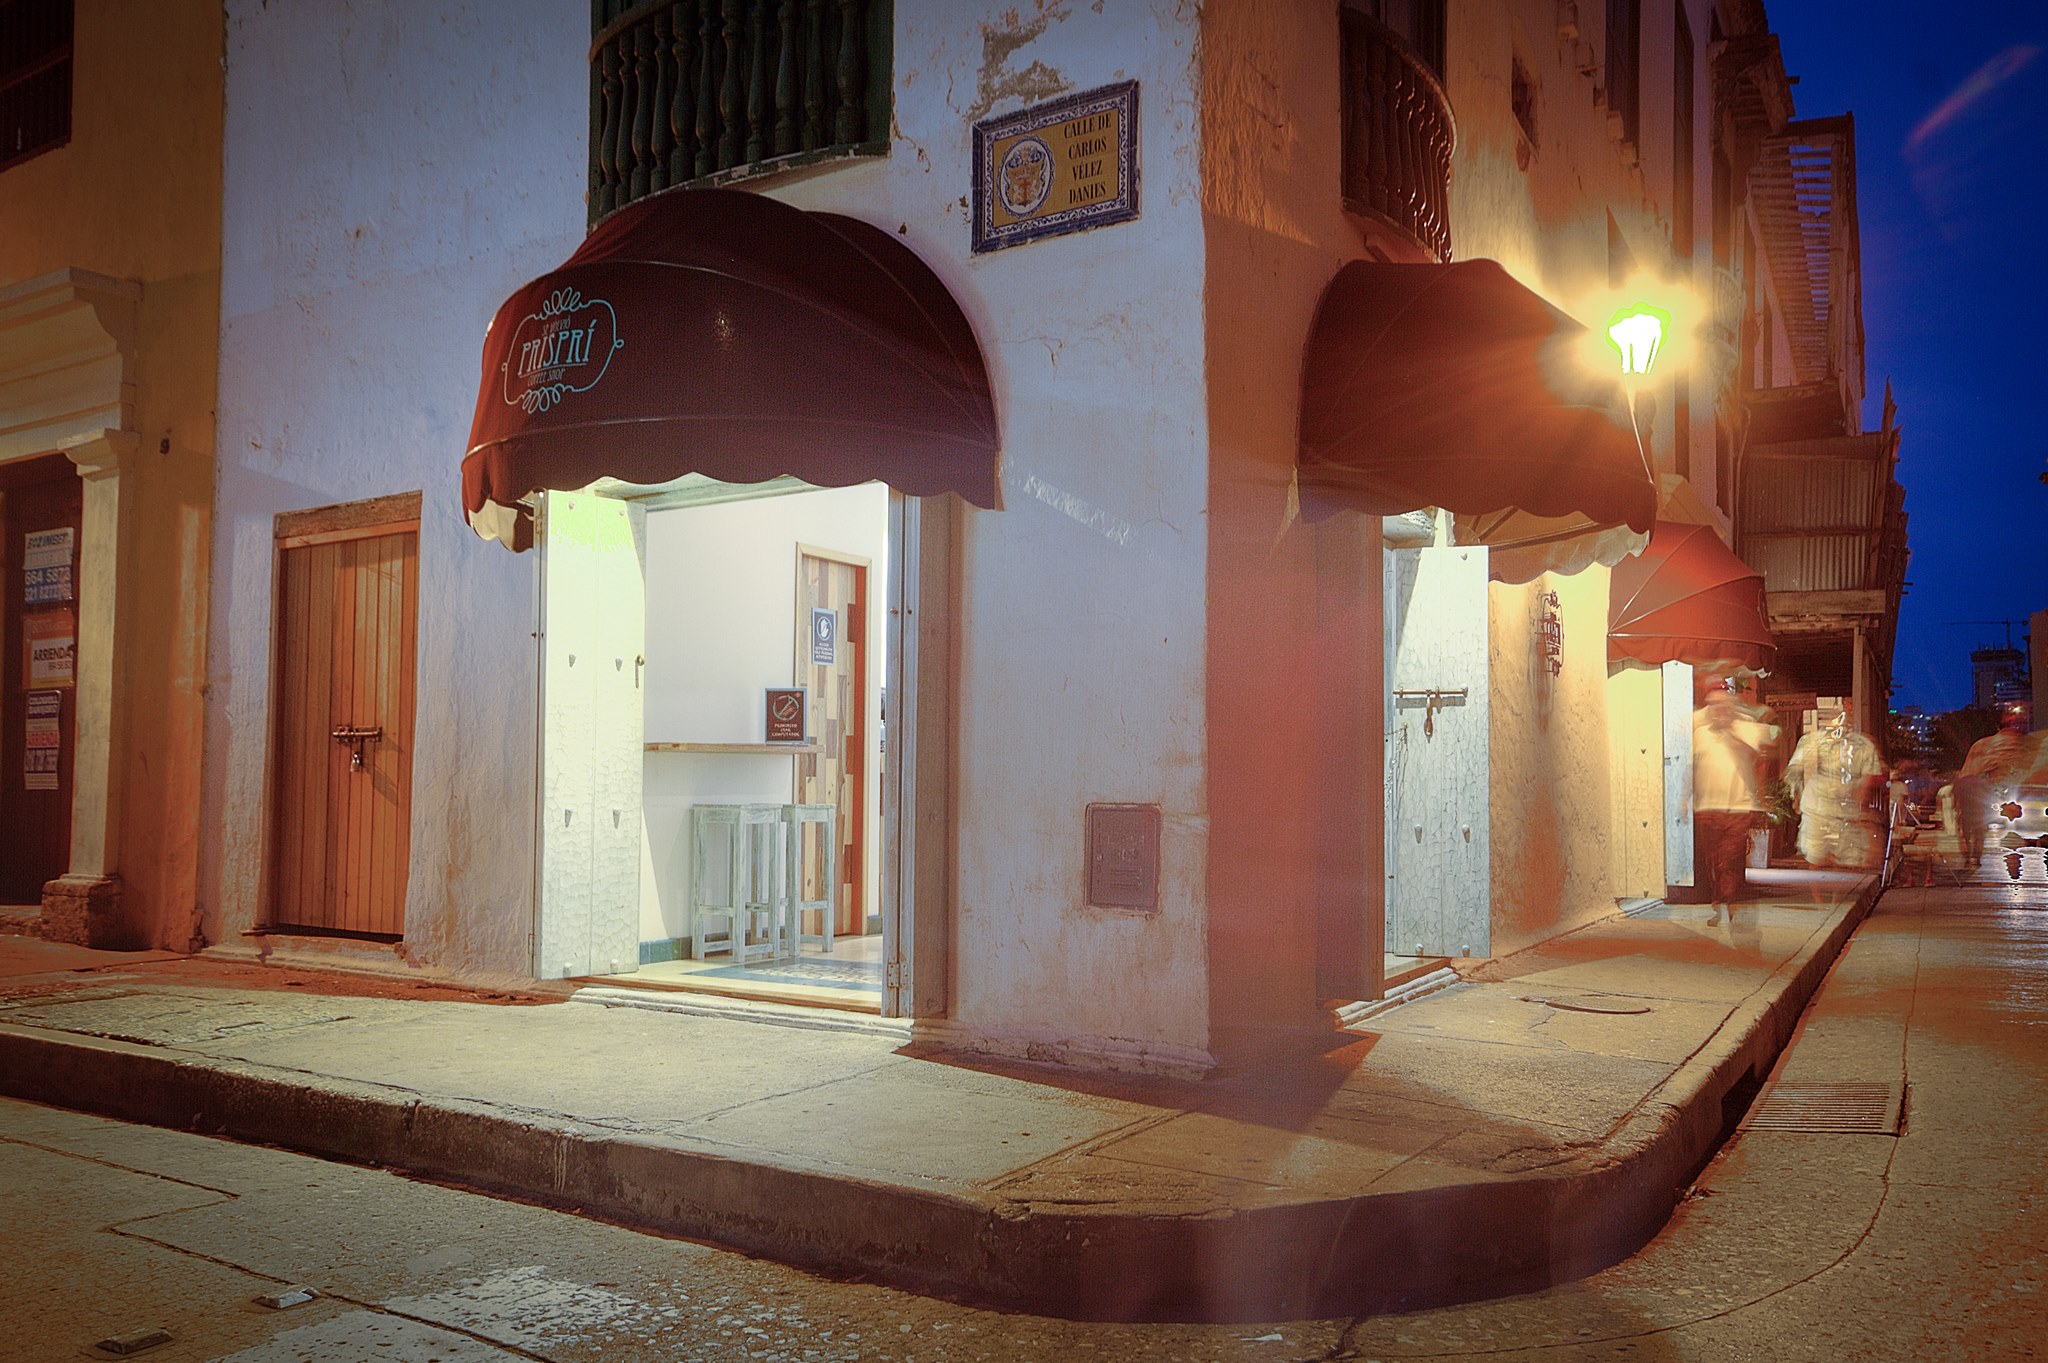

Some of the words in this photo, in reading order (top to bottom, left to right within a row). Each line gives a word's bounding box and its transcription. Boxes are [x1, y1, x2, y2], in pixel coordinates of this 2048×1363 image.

[1064, 118, 1095, 138] CALLE
[1098, 113, 1111, 129] DE
[1069, 138, 1107, 159] CARLOS
[1073, 160, 1102, 181] VÉLEZ
[1069, 183, 1106, 204] DANIES
